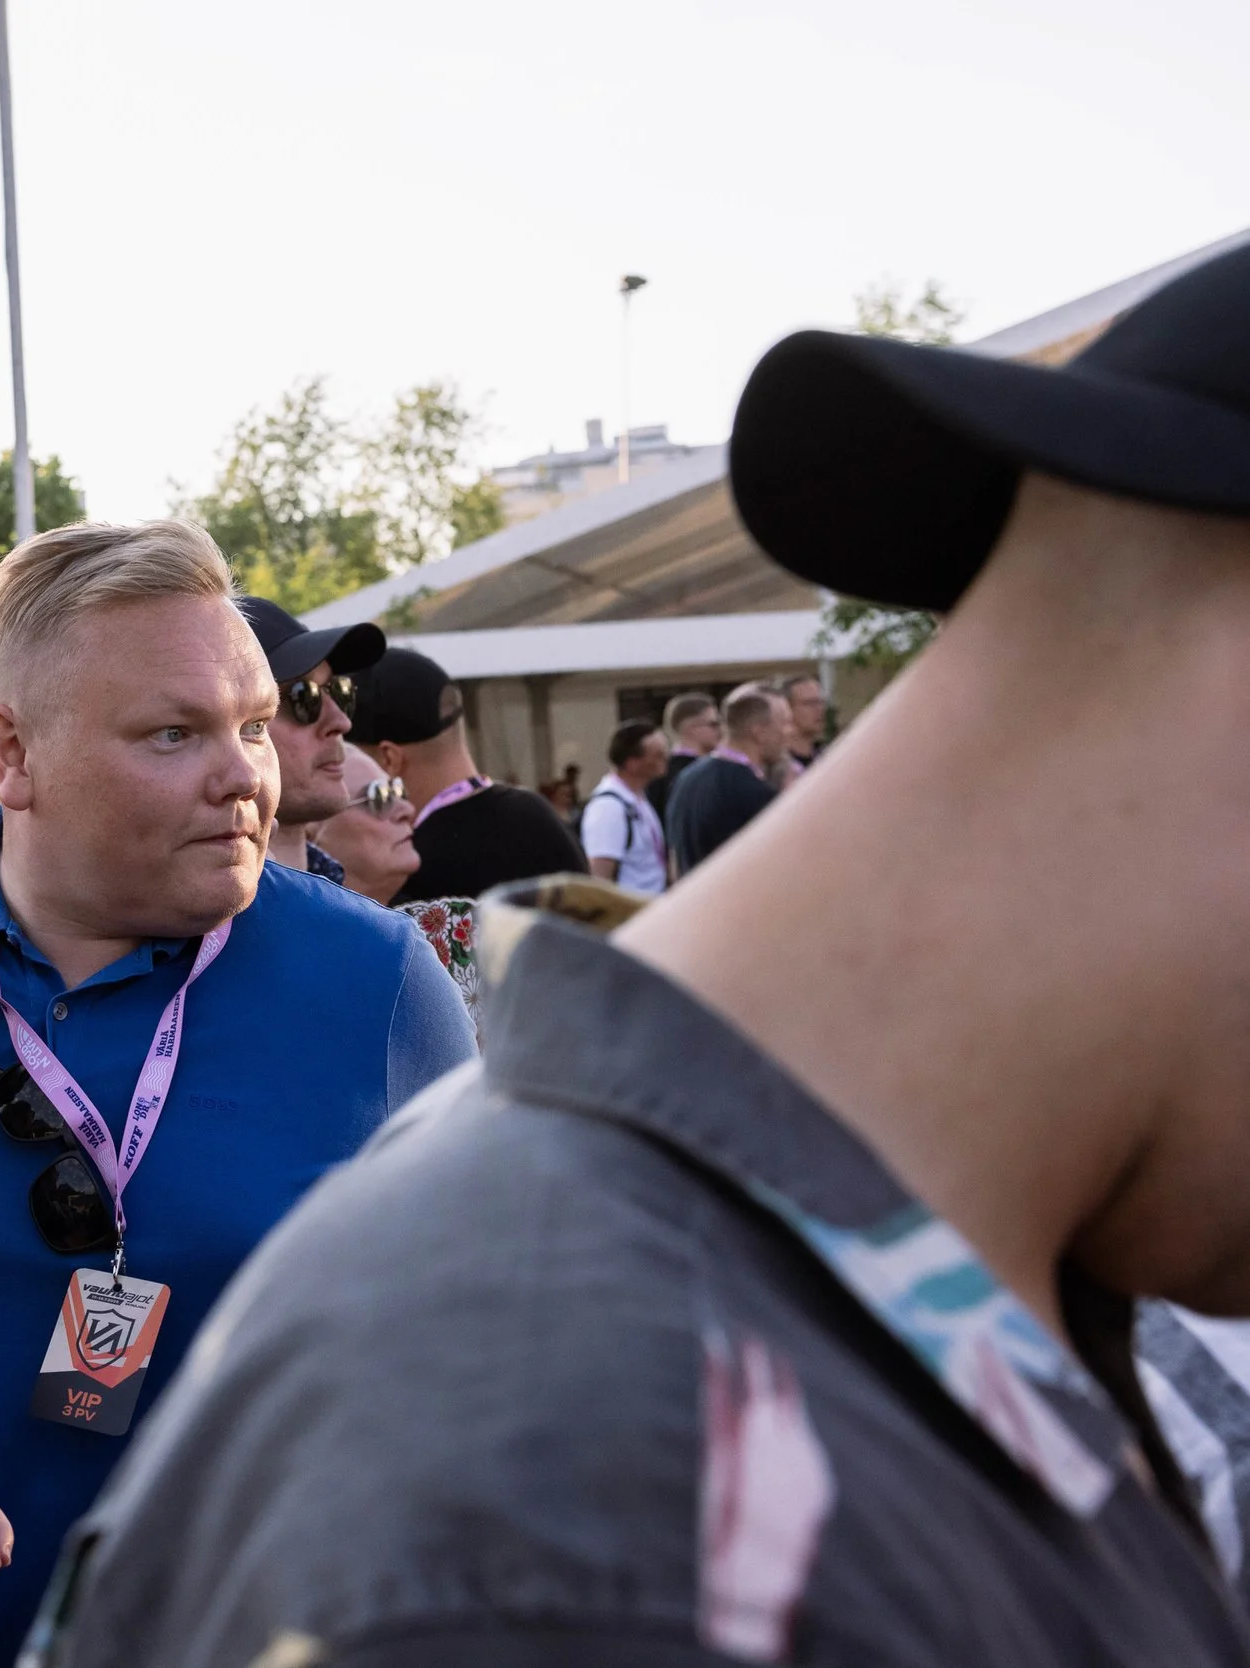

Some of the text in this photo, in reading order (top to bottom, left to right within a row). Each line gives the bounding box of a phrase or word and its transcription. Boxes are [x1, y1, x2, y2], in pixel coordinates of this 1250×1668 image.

[164, 994, 181, 1057] HARMAASEEN
[155, 1030, 169, 1056] VÄRIÄ
[21, 1046, 41, 1071] LOUD
[64, 1086, 107, 1145] HARMAASEEN
[78, 1121, 100, 1149] VÄRIÄ
[124, 1125, 144, 1169] KOFF
[68, 1388, 102, 1408] VIP
[62, 1405, 96, 1421] 3 PV
